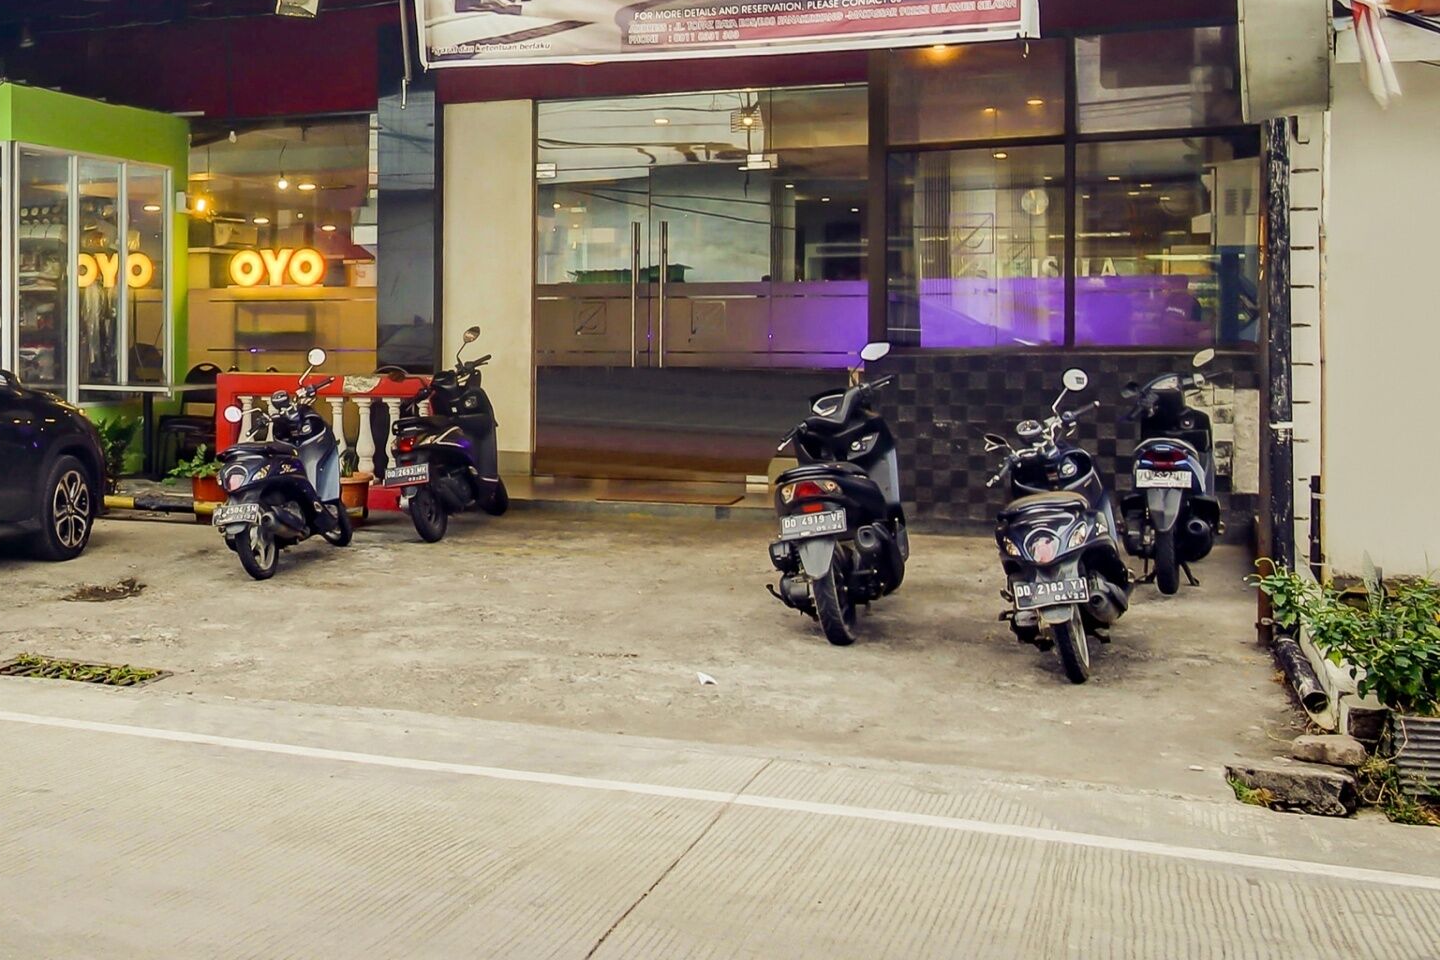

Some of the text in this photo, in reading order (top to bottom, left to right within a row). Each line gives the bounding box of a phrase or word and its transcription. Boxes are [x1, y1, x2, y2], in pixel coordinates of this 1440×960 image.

[634, 11, 653, 21] FOR
[655, 9, 682, 20] MORE
[684, 6, 717, 18] DETAILS
[719, 4, 739, 16] AND
[73, 253, 153, 289] OYO
[230, 248, 325, 288] OYO
[784, 519, 797, 529] DD
[801, 515, 825, 526] 4919
[1016, 584, 1031, 598] DD
[1037, 581, 1064, 595] 2183
